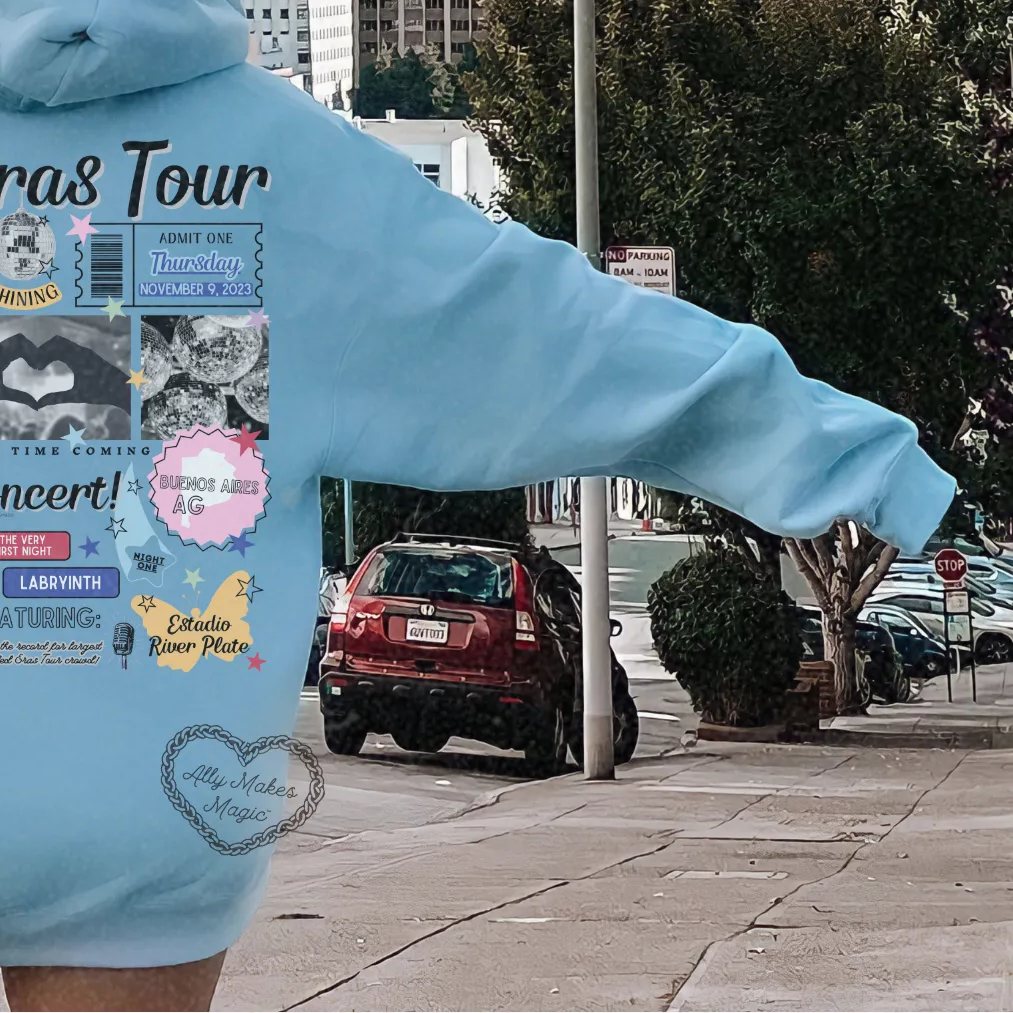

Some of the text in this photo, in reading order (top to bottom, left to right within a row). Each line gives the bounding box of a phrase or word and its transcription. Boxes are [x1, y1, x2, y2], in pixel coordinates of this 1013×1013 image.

[122, 139, 271, 221] Tour
[159, 232, 233, 244] ADMIT ONE
[608, 250, 670, 261] NO PARKING
[149, 249, 244, 280] Thursday
[644, 268, 668, 277] 10AM
[140, 283, 252, 297] NOVEMBER 9, 2023
[11, 446, 60, 456] TIME
[72, 446, 151, 456] COMING
[159, 474, 259, 495] BUENOS AIRES
[172, 494, 205, 515] AG
[0, 534, 46, 545] THE VERY
[22, 546, 52, 556] NIGHT
[133, 552, 165, 566] NIGHT
[937, 559, 965, 572] STOP
[137, 561, 158, 573] ONE
[20, 575, 101, 590] LABRYINTH
[167, 614, 232, 635] Estadio
[0, 640, 14, 651] the
[16, 641, 48, 651] record
[46, 642, 67, 653] for
[68, 640, 103, 656] largest
[149, 634, 250, 657] River Plate
[14, 653, 39, 665] Eras
[40, 653, 63, 665] Tour
[64, 654, 100, 665] crowd!
